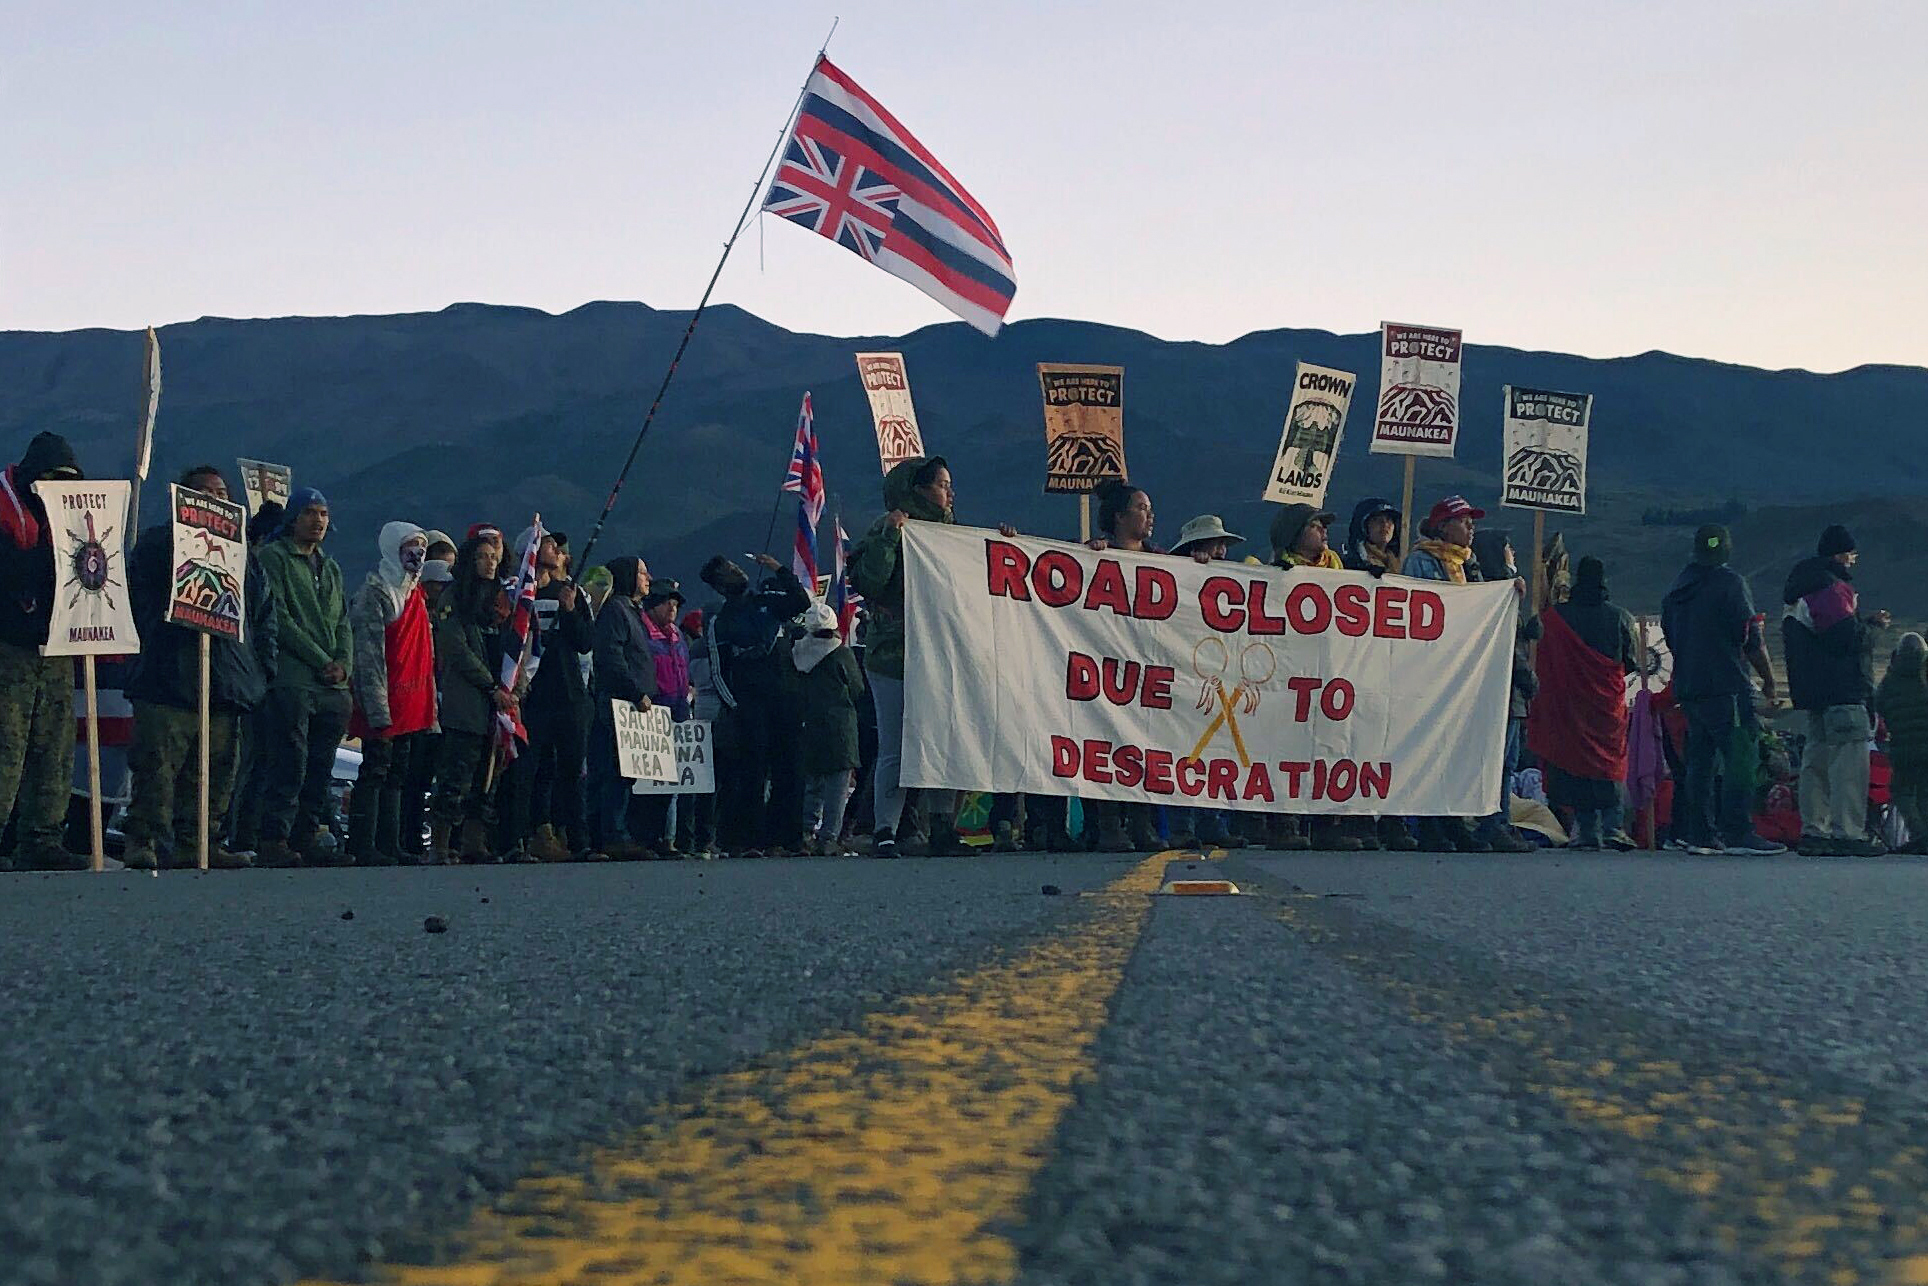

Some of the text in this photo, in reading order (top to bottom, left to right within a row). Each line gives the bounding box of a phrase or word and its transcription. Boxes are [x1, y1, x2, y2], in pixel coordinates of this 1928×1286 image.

[1391, 341, 1453, 359] PROTECT
[1049, 387, 1115, 404] PROTECT
[1300, 372, 1351, 398] CROWN
[1516, 402, 1580, 423] PROTECT
[1380, 424, 1449, 440] MAUNAKEA
[1048, 478, 1097, 489] MAUNA
[1276, 466, 1322, 488] LANDS
[62, 494, 107, 509] PROTECT
[1508, 488, 1579, 506] MAUNAKEA
[181, 506, 237, 538] PROTECT
[985, 538, 1446, 642] ROAD CLOSED
[69, 626, 115, 642] MAUNAKEA
[1066, 650, 1356, 722] DUE TO
[619, 704, 671, 737] SACRED
[620, 730, 670, 755] MAUNA
[673, 724, 705, 744] RED
[632, 753, 663, 776] KEA
[674, 745, 704, 764] NA
[1050, 734, 1392, 803] DESECRATION
